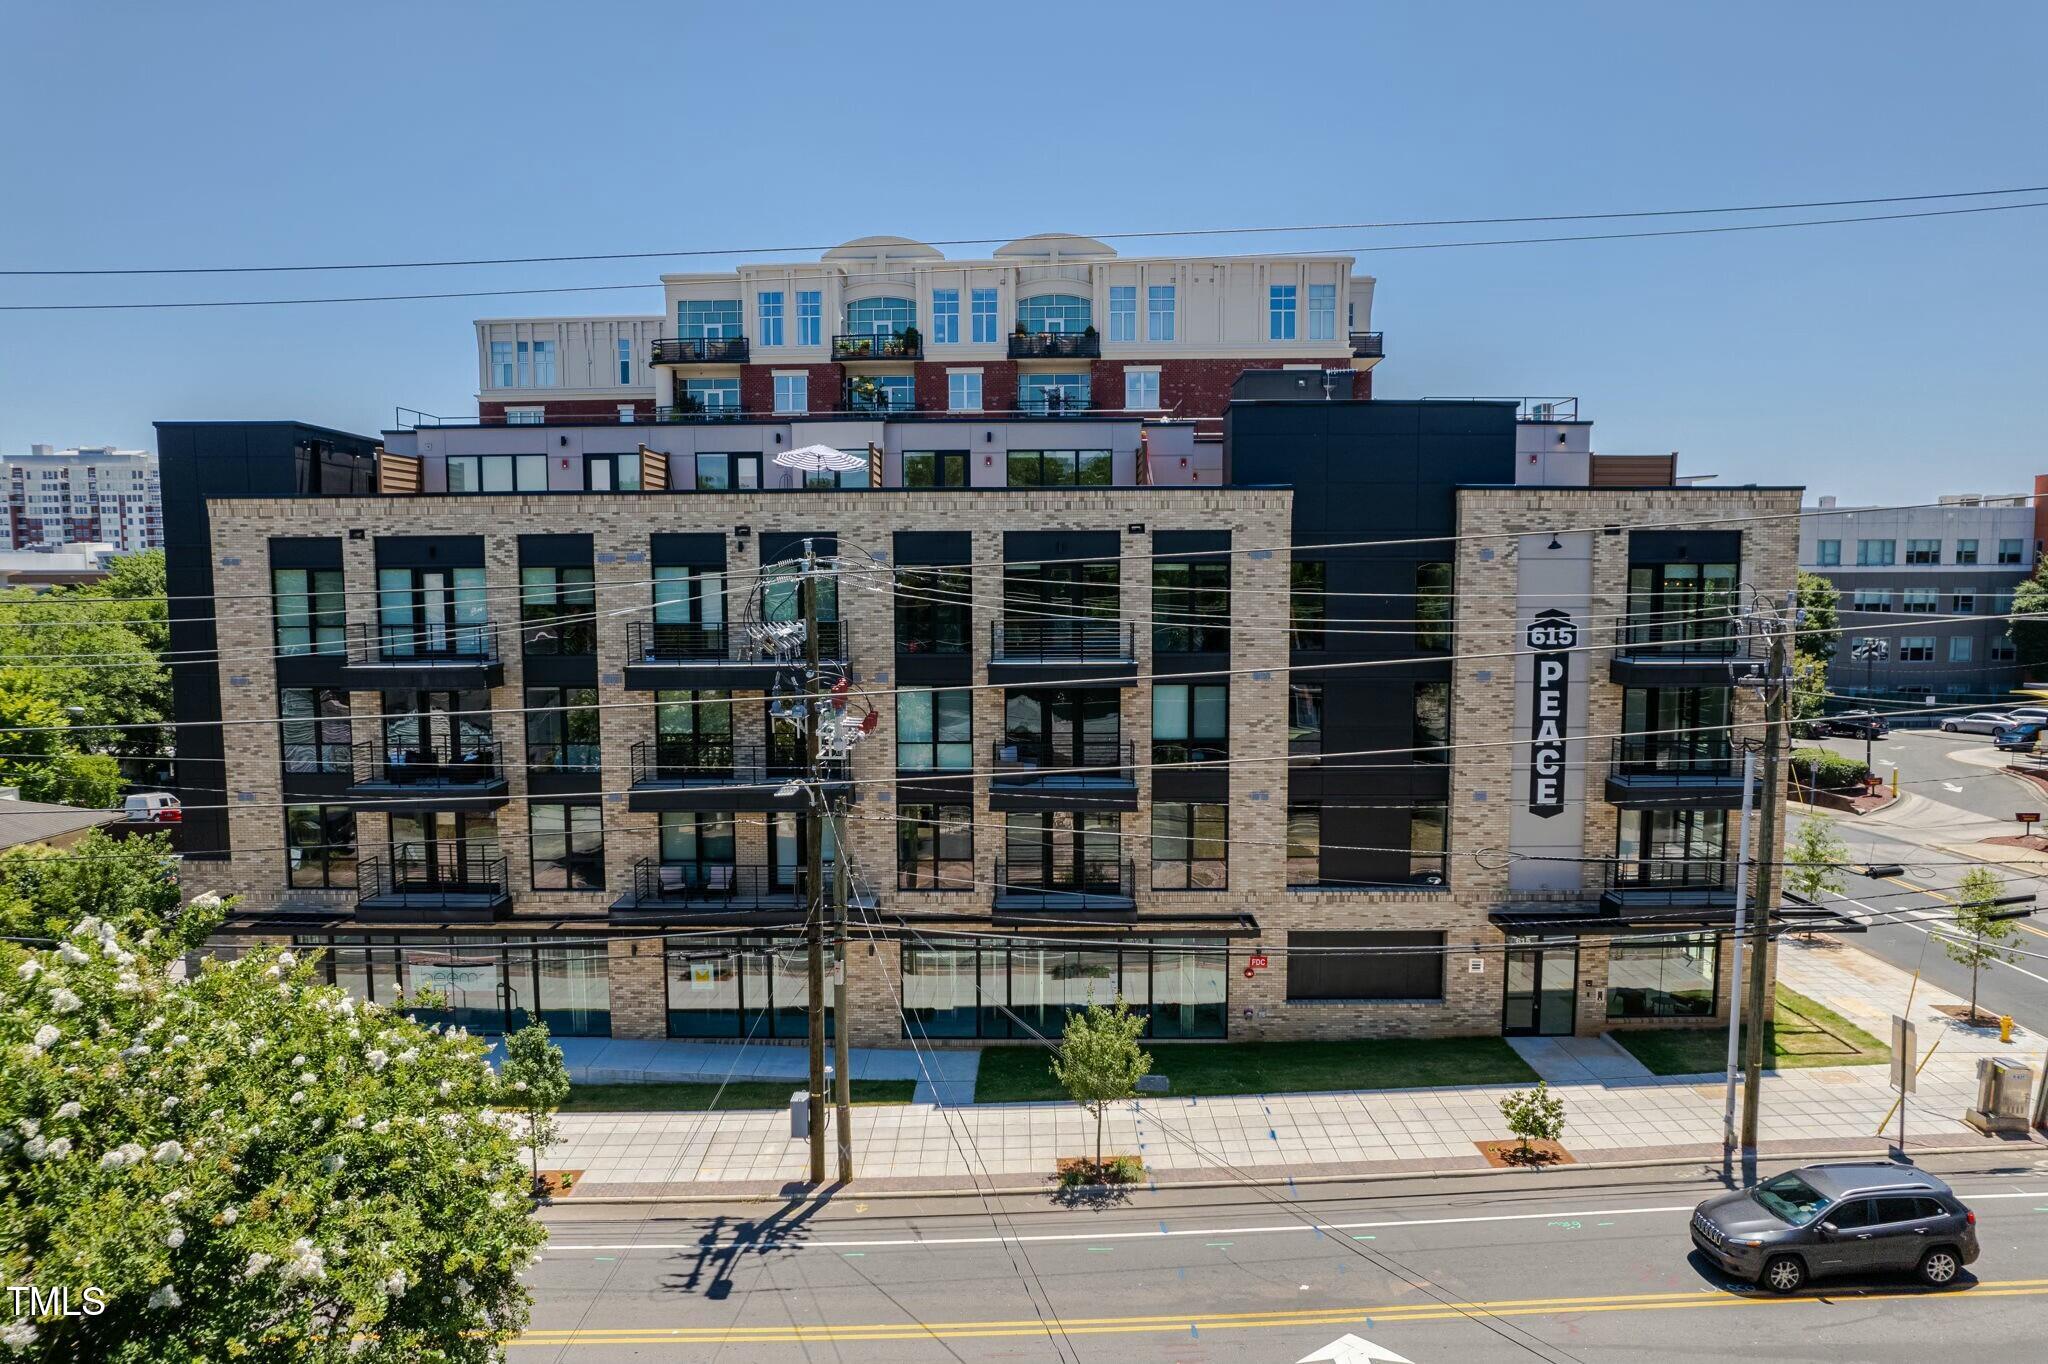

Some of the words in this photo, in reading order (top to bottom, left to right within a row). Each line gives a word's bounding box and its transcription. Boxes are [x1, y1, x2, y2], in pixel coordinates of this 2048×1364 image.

[1531, 627, 1573, 645] 615
[1535, 661, 1563, 804] PEACE
[1251, 958, 1266, 966] FDC
